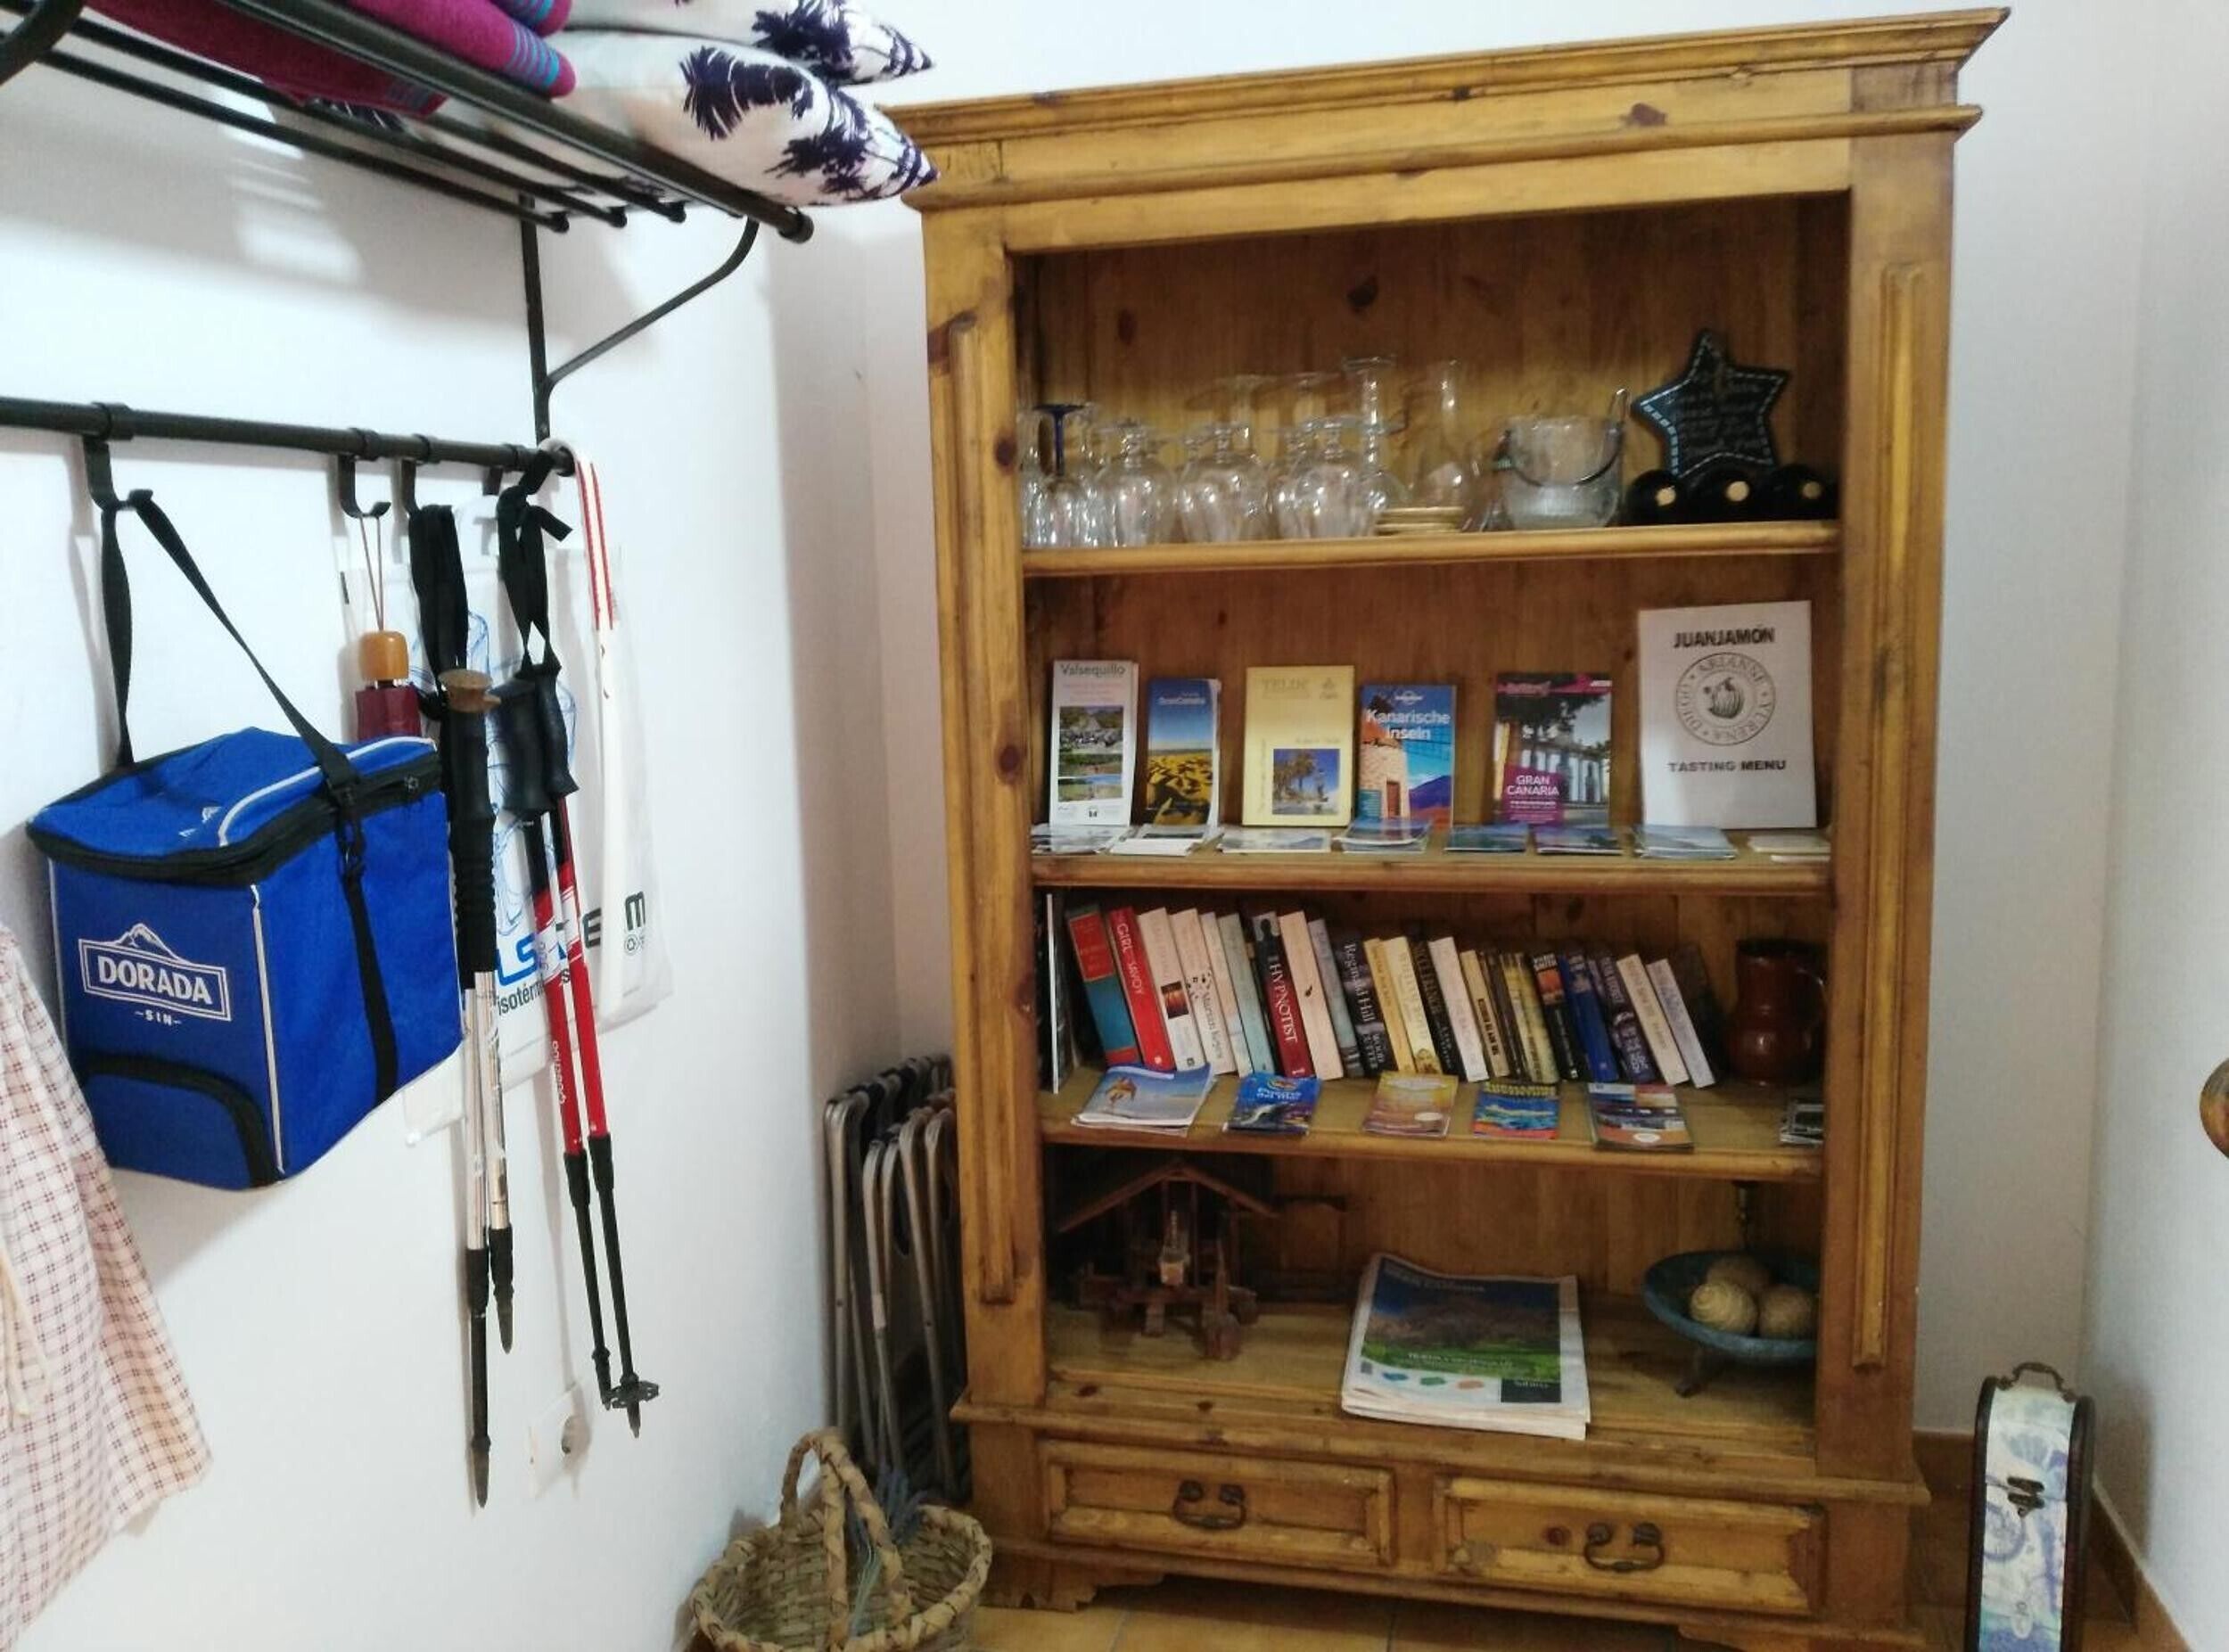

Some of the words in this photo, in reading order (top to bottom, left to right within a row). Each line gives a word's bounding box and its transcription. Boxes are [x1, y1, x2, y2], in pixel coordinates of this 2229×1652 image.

[1674, 623, 1775, 648] JUANJAMÓN
[1060, 662, 1127, 678] Valsequillo
[1366, 709, 1452, 725] Kanarische
[1386, 726, 1431, 740] Inseln
[1668, 760, 1736, 772] TASTING
[1740, 760, 1787, 771] MENU
[1516, 775, 1550, 785] GRAN
[1507, 785, 1559, 796] CANARIA
[1116, 923, 1133, 953] GIRL
[97, 955, 214, 1006] DORADA
[1269, 964, 1298, 1043] HYPNOTIST
